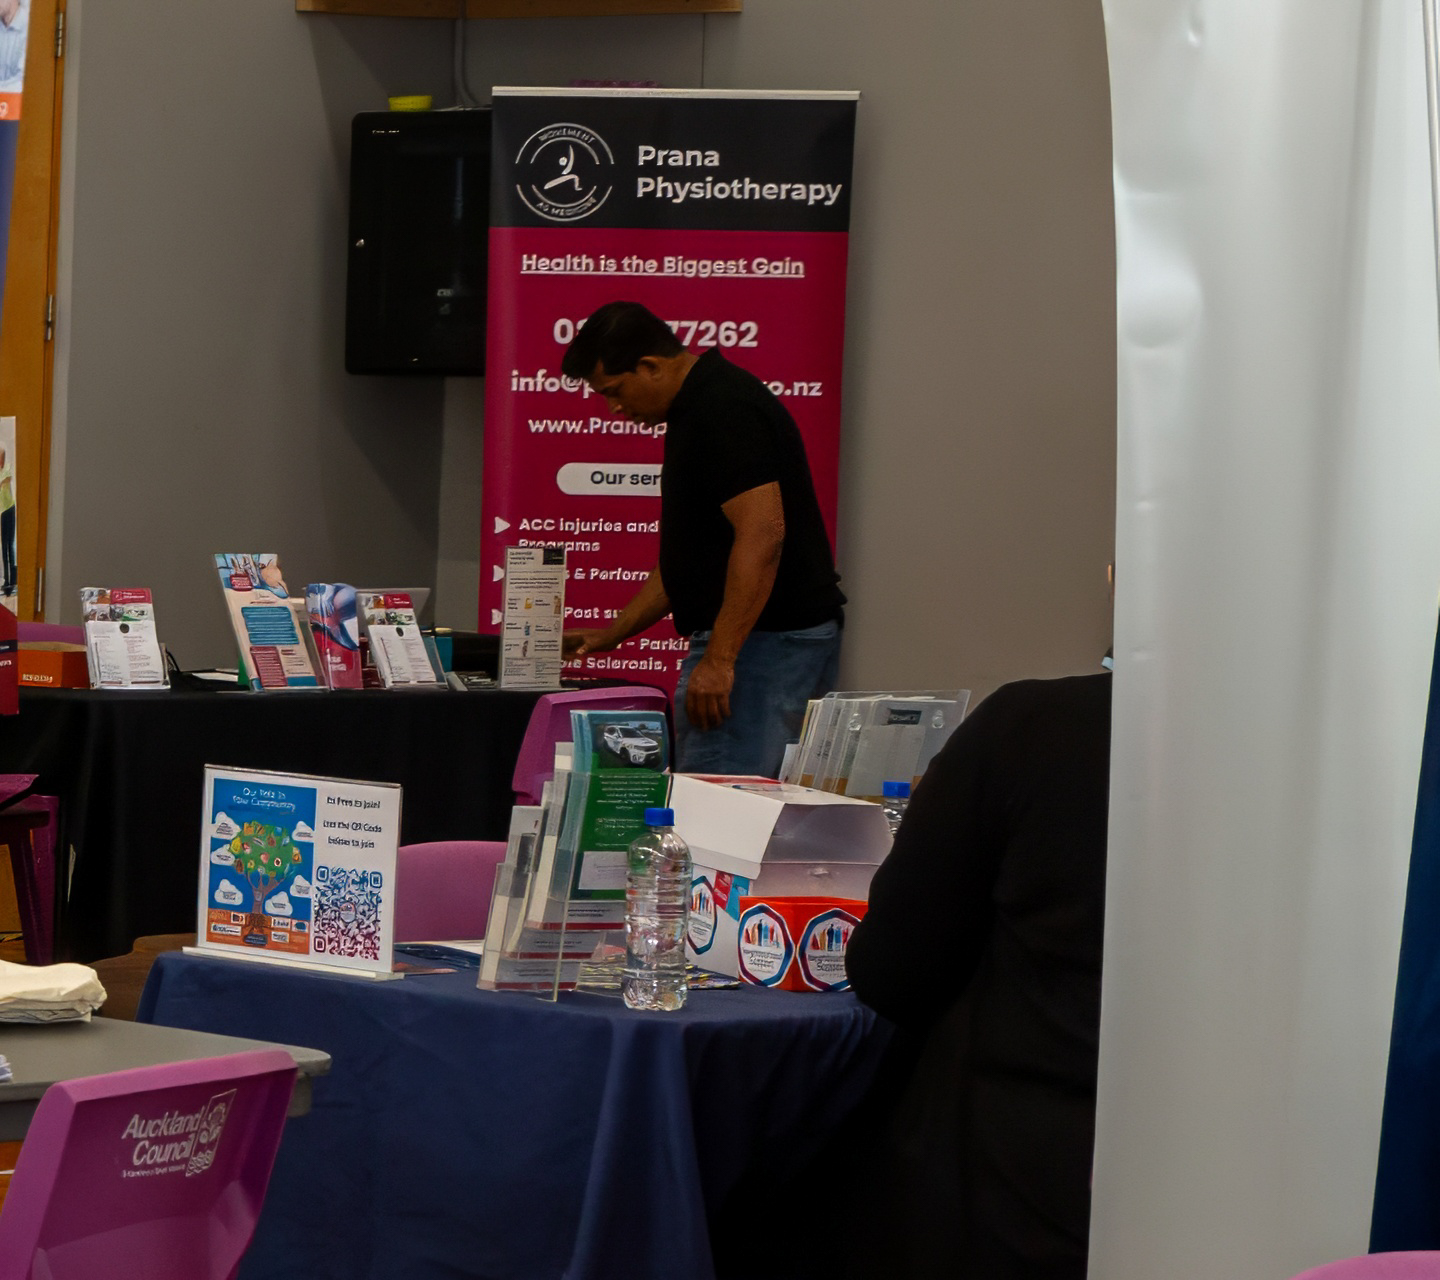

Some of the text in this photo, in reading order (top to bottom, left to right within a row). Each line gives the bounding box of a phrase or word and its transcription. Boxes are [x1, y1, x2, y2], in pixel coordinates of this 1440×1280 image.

[637, 144, 720, 169] Prana
[637, 176, 842, 205] Physiotherapy
[521, 253, 805, 279] Health is the Biggest Gain
[590, 469, 625, 487] Our
[519, 518, 555, 532] ACC
[122, 1105, 206, 1141] Auckland
[133, 1133, 196, 1166] Council
